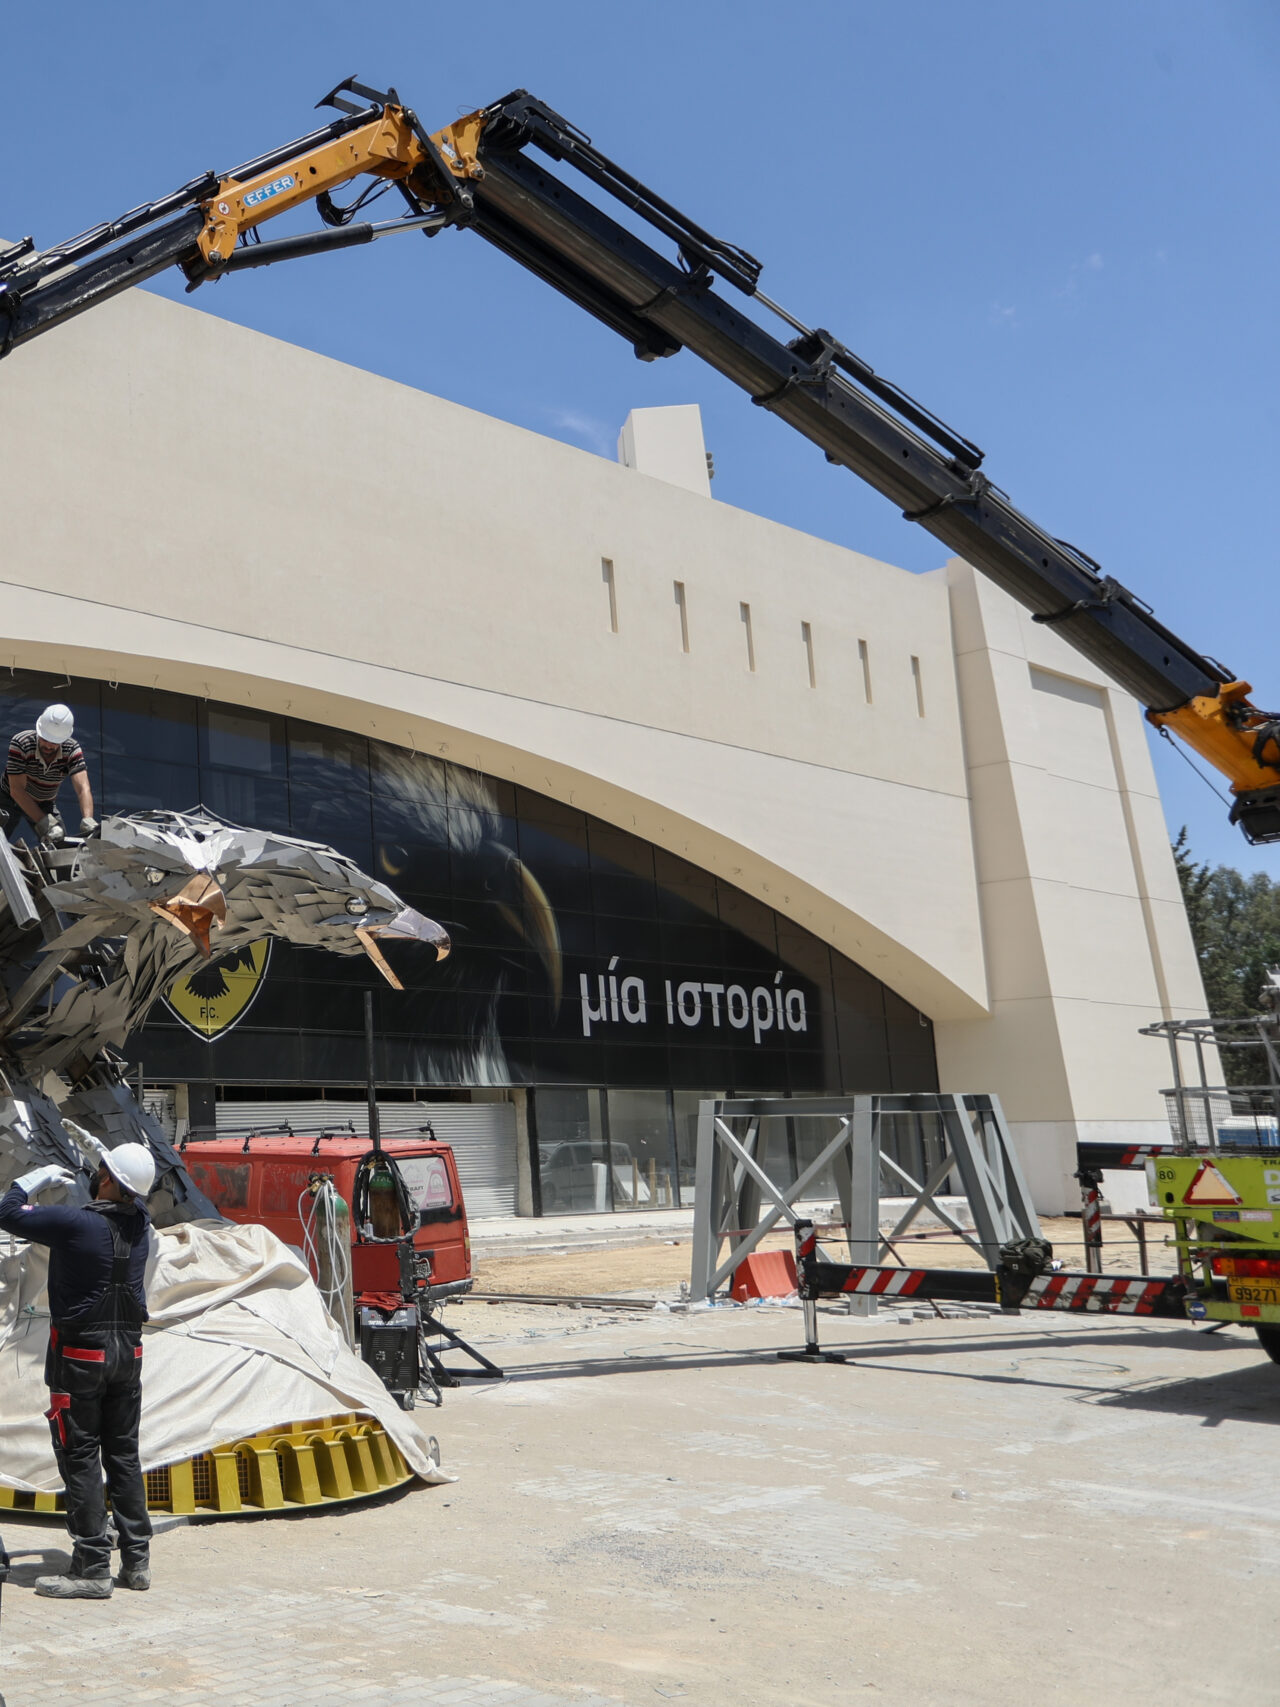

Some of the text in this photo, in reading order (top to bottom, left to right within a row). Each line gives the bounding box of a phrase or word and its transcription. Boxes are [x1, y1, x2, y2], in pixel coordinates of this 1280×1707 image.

[247, 177, 292, 205] EFFER
[579, 956, 808, 1044] μία ιστορία
[200, 1006, 219, 1018] F.C.
[1159, 1170, 1174, 1180] 80
